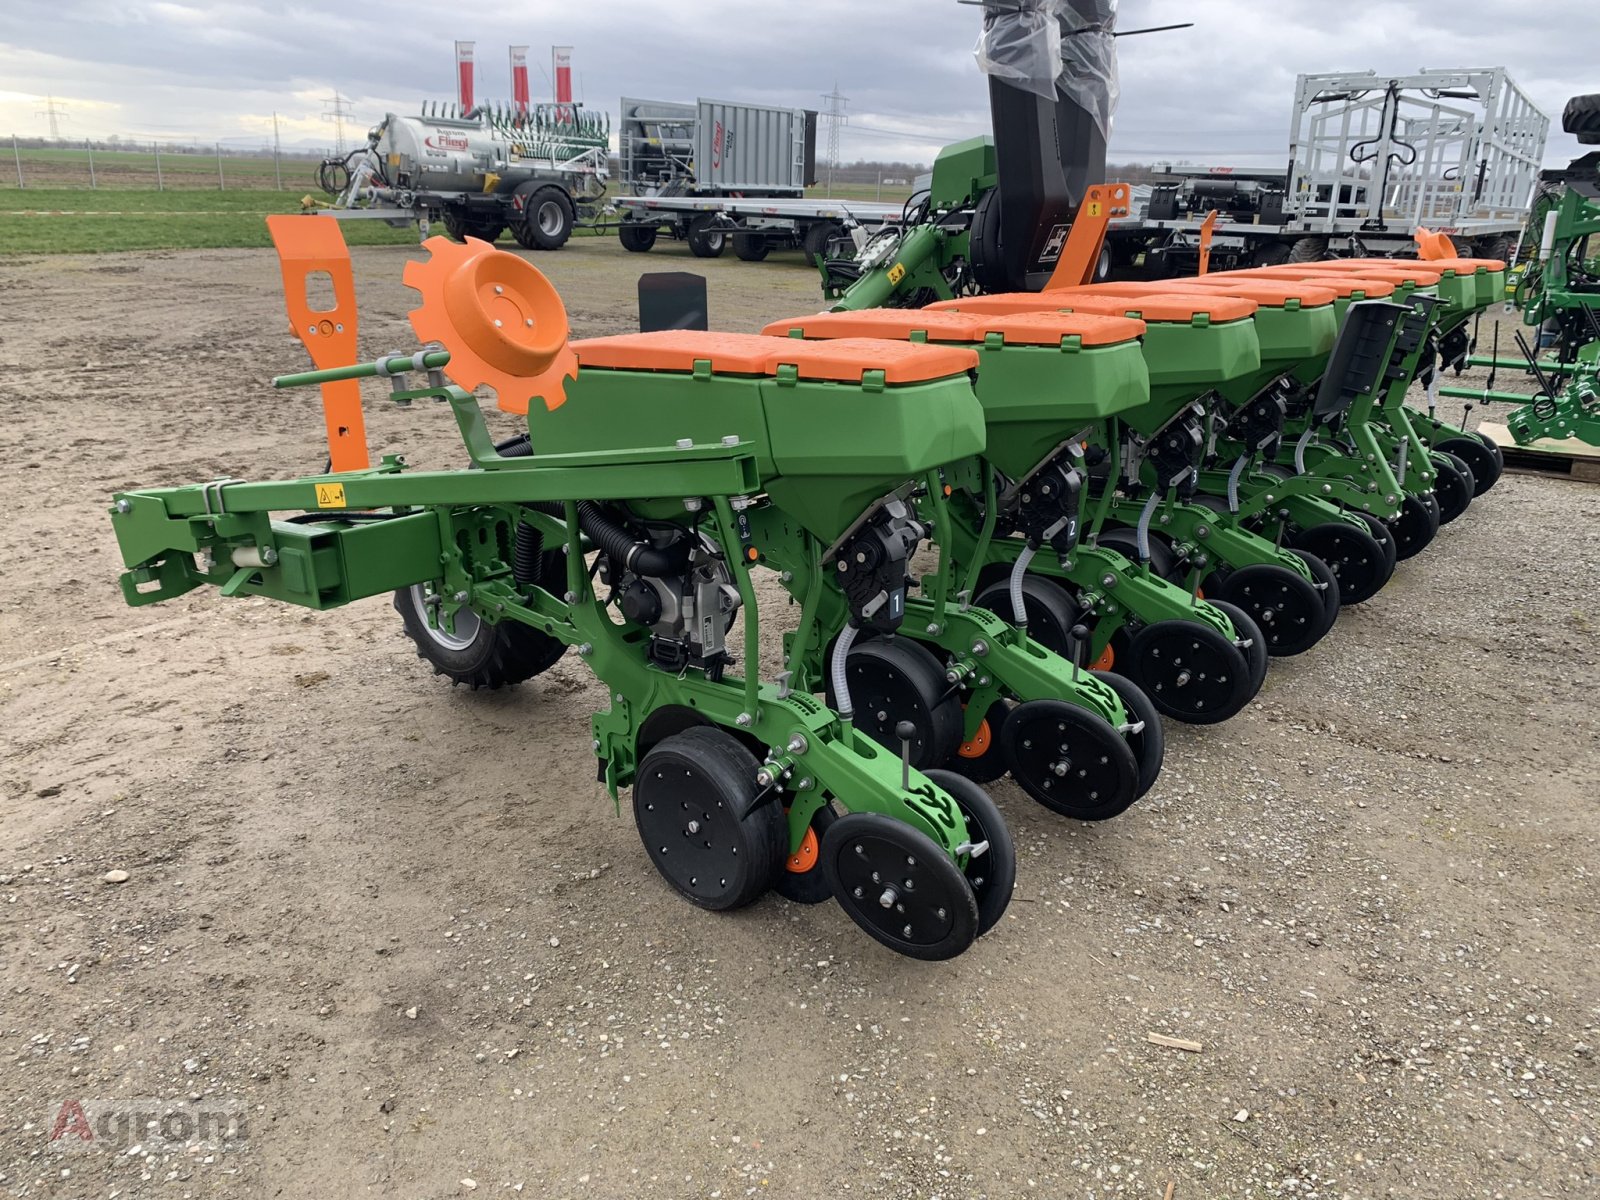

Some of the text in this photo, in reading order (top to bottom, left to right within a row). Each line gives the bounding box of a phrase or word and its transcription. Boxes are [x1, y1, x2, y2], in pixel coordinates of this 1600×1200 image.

[438, 135, 469, 150] Fliegl
[1069, 520, 1076, 537] 2
[893, 594, 900, 613] 1
